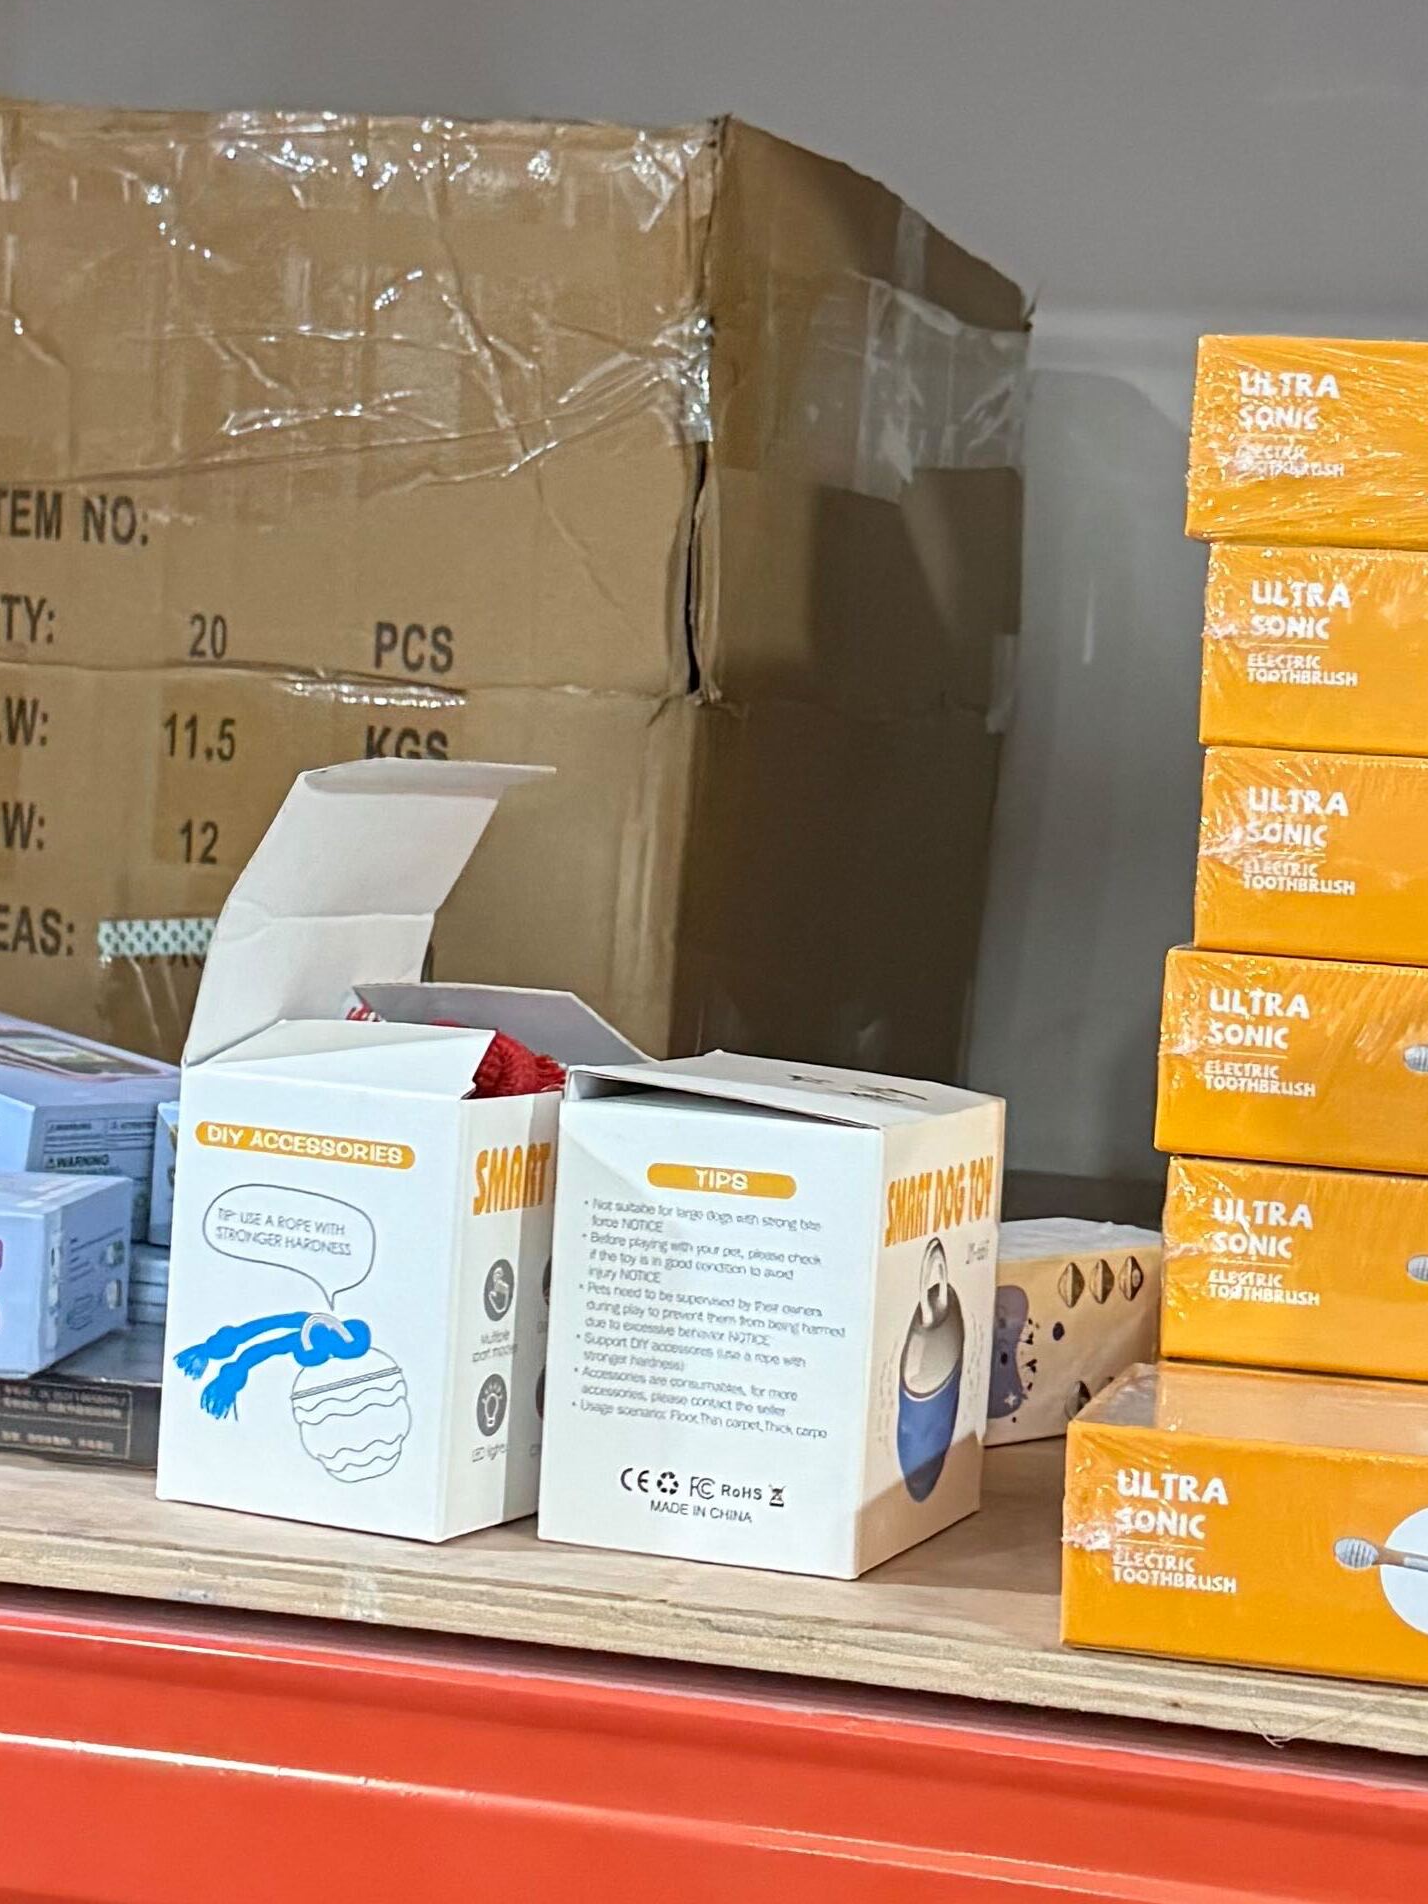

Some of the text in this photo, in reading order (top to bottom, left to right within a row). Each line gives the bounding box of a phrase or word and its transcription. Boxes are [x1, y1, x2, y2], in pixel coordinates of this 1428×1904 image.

[82, 492, 150, 546] NO:
[1251, 580, 1351, 609] ULTRA
[1249, 615, 1330, 640] SONIC
[189, 614, 228, 660] 20
[374, 622, 454, 674] PCS
[162, 714, 236, 762] 11.5
[1247, 785, 1349, 817] ULTRA
[178, 820, 218, 865] 12
[1245, 821, 1328, 847] SONIC
[1243, 860, 1318, 878] ELECTRIC
[1243, 875, 1356, 896] TOOTHBRUSH
[1209, 988, 1310, 1019] ULTRA
[1207, 1022, 1289, 1050] SONIC
[1204, 1059, 1280, 1080] ELECTRIC
[1203, 1074, 1316, 1097] TOOTHBRUSH
[207, 1125, 403, 1165] DIY ACCESSORIES
[473, 1143, 551, 1216] SMART
[695, 1168, 748, 1191] TIPS
[933, 1163, 965, 1232] DOG
[969, 1156, 993, 1222] TOY
[240, 1212, 261, 1226] USE
[264, 1215, 274, 1227] A
[277, 1216, 312, 1232] ROPE
[315, 1220, 344, 1235] WITH
[1213, 1197, 1314, 1231] ULTRA
[1211, 1231, 1293, 1259] SONIC
[620, 1467, 650, 1493] CE
[722, 1484, 763, 1501] RoHS
[1117, 1469, 1228, 1505] ULTRA
[650, 1500, 752, 1523] MADE IN CHINA
[1114, 1506, 1205, 1539] SONIC
[1112, 1550, 1195, 1573] ELECTRIC
[1112, 1564, 1237, 1594] TOOTHBRUSH
